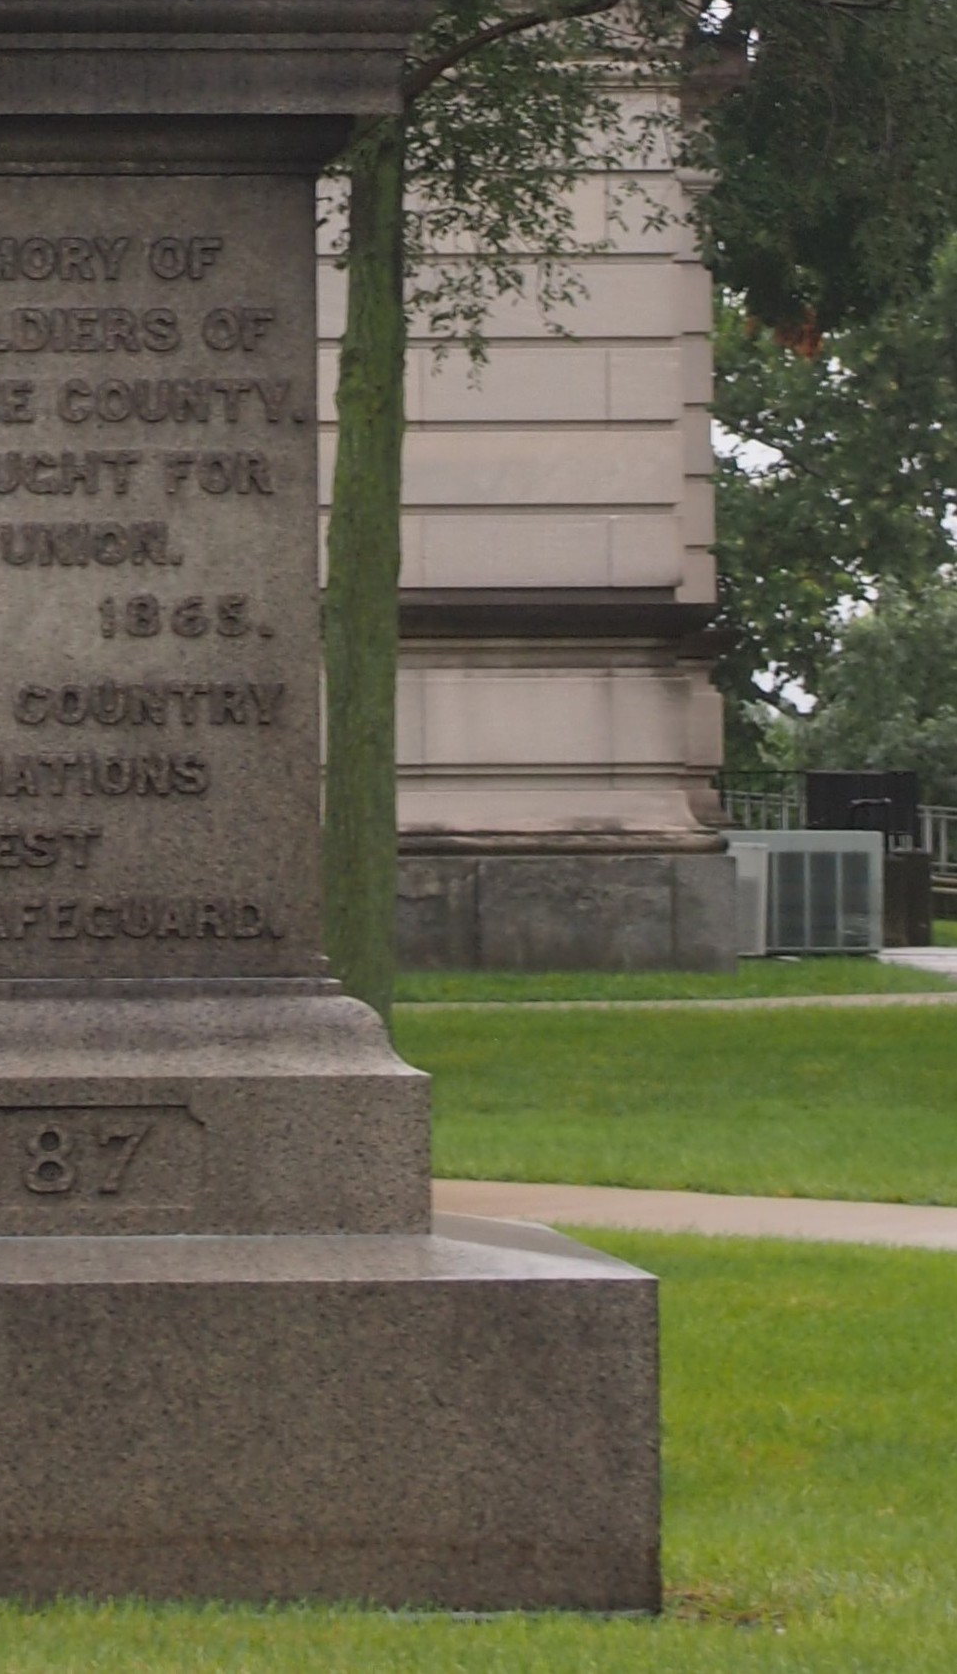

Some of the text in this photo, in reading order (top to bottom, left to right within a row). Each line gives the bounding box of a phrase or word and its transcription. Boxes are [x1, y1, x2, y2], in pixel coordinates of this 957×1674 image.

[149, 237, 223, 279] OF
[201, 306, 275, 352] OF
[162, 449, 275, 495] FOR
[96, 594, 277, 639] 1865.
[12, 681, 287, 726] COUNTRY
